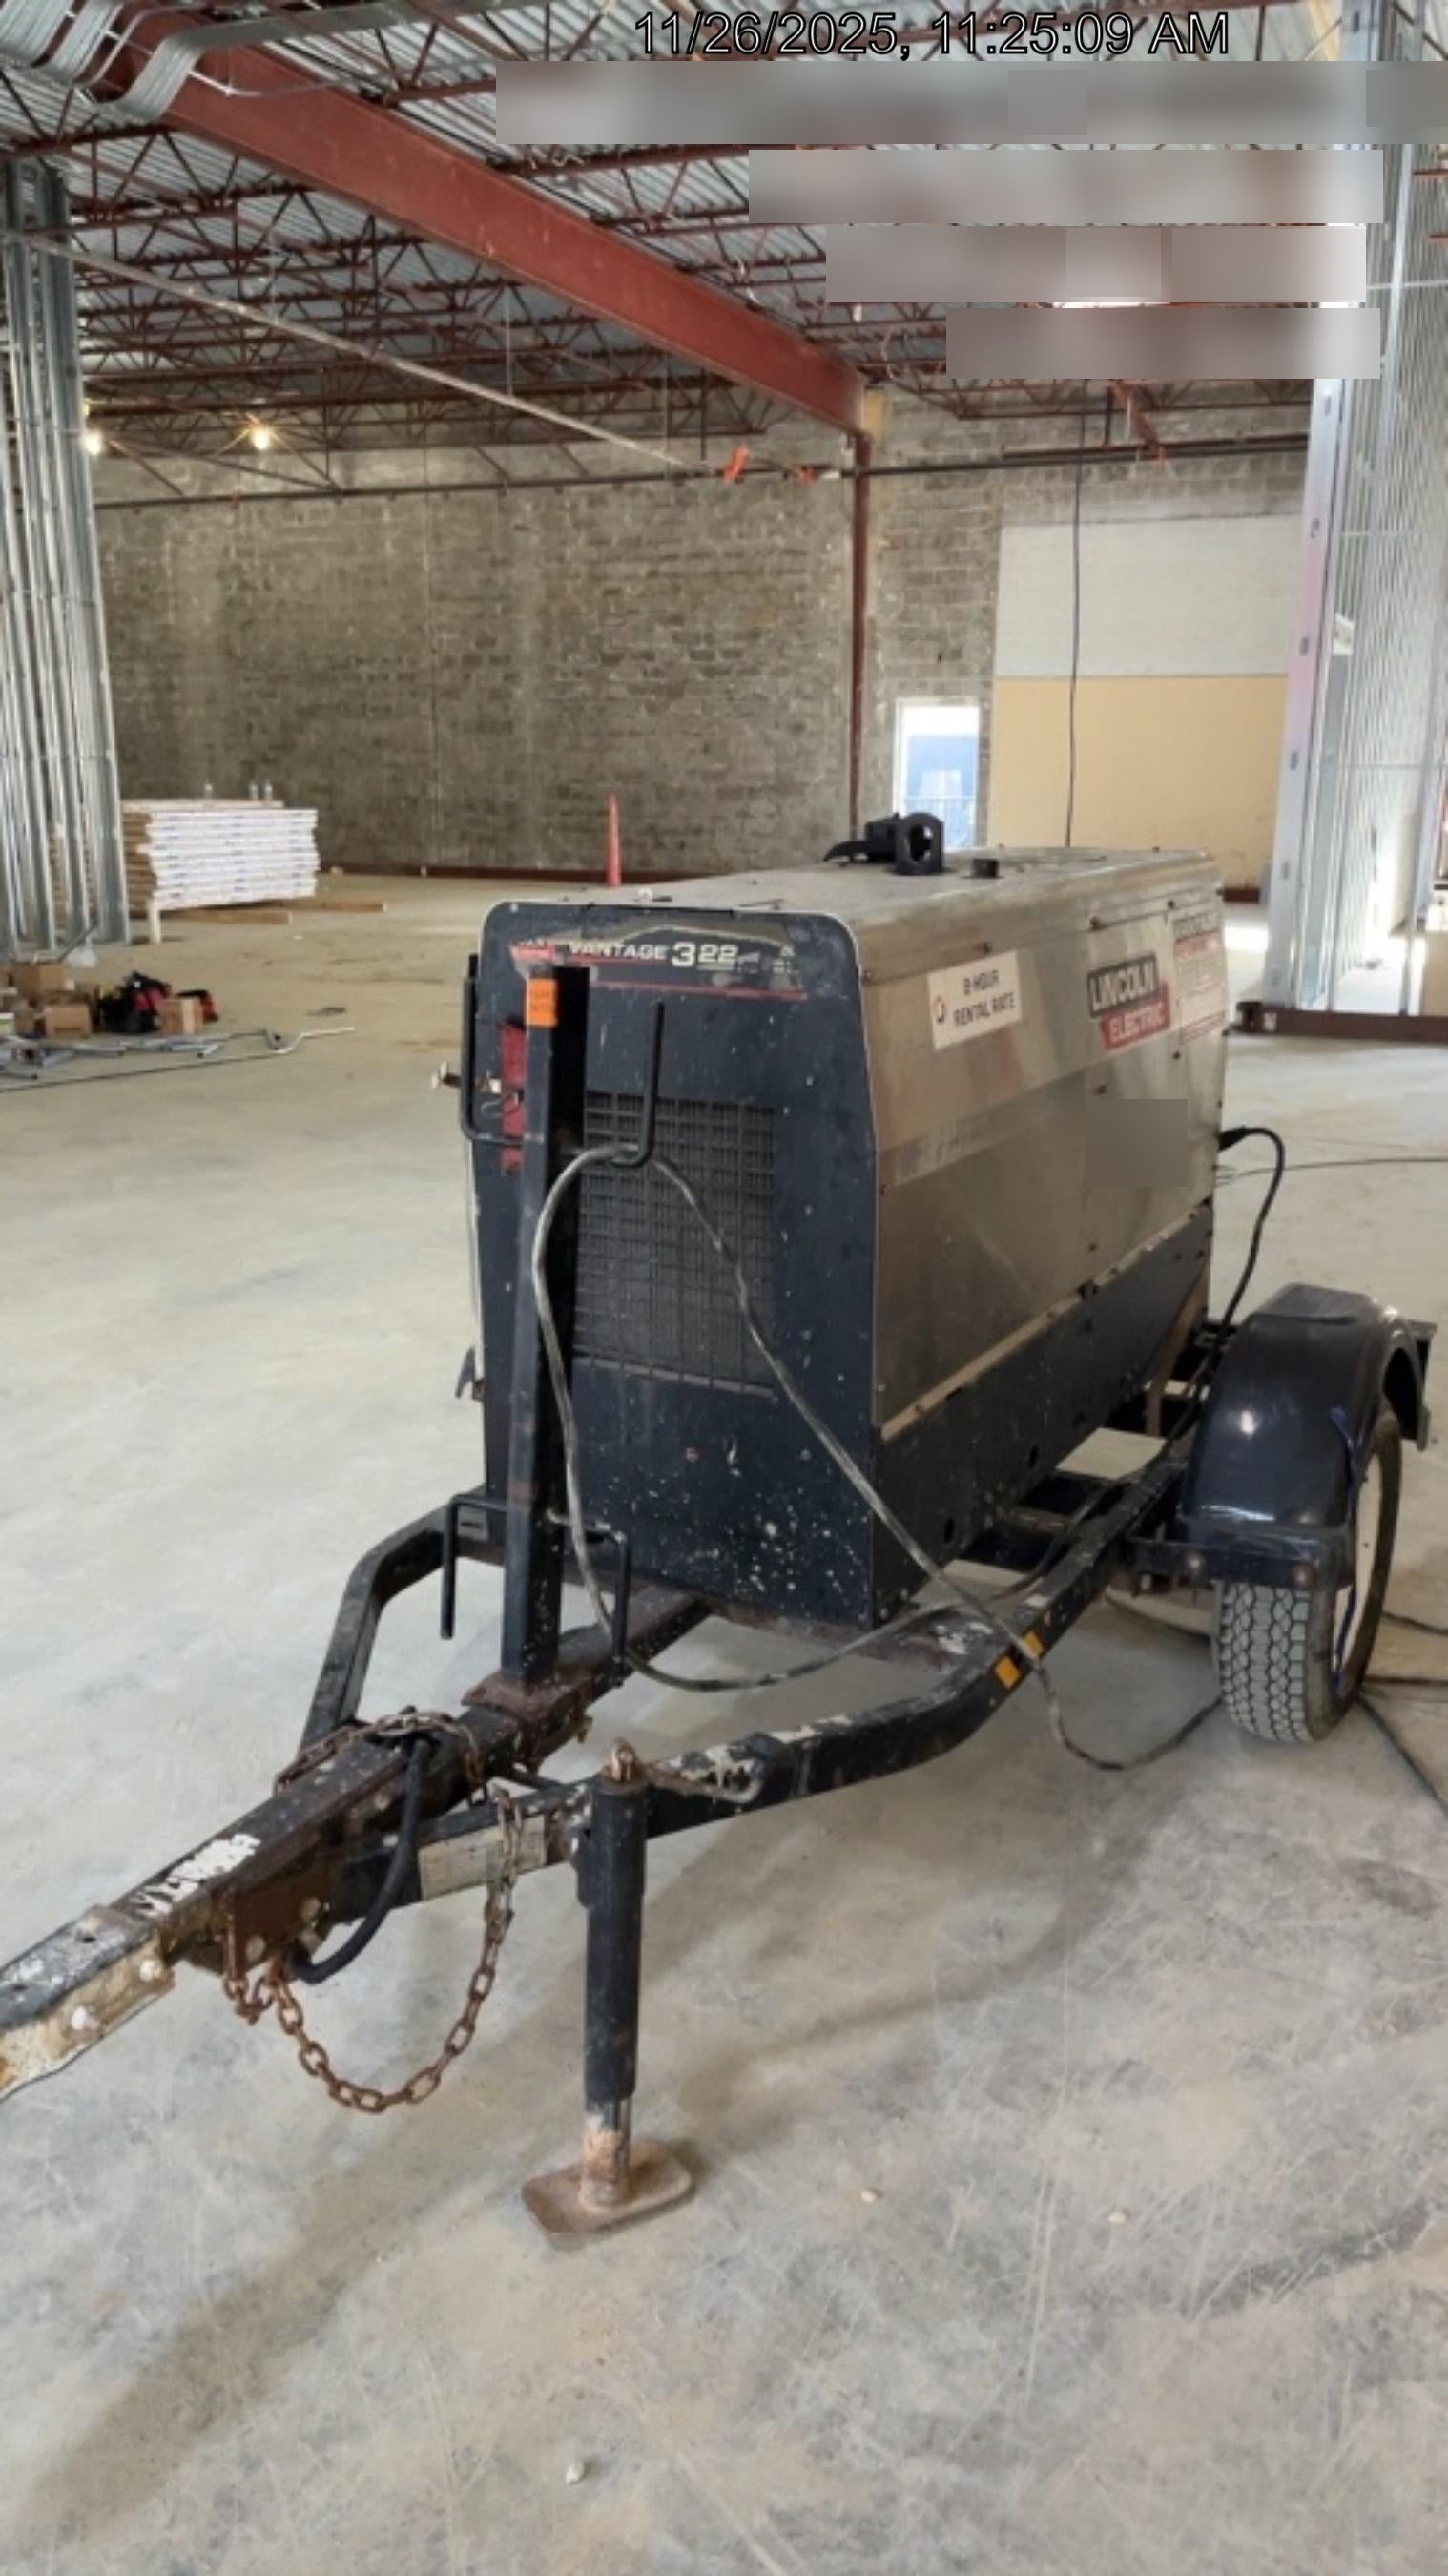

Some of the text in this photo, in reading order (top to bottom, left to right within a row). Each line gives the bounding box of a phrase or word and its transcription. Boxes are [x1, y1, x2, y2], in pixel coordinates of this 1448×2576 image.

[569, 939, 668, 960] VANTAGE
[672, 941, 738, 966] 322
[1089, 960, 1155, 1012] LINCOLN
[954, 992, 1016, 1028] RENTAL RATE
[1108, 1000, 1164, 1044] ELECTRIC
